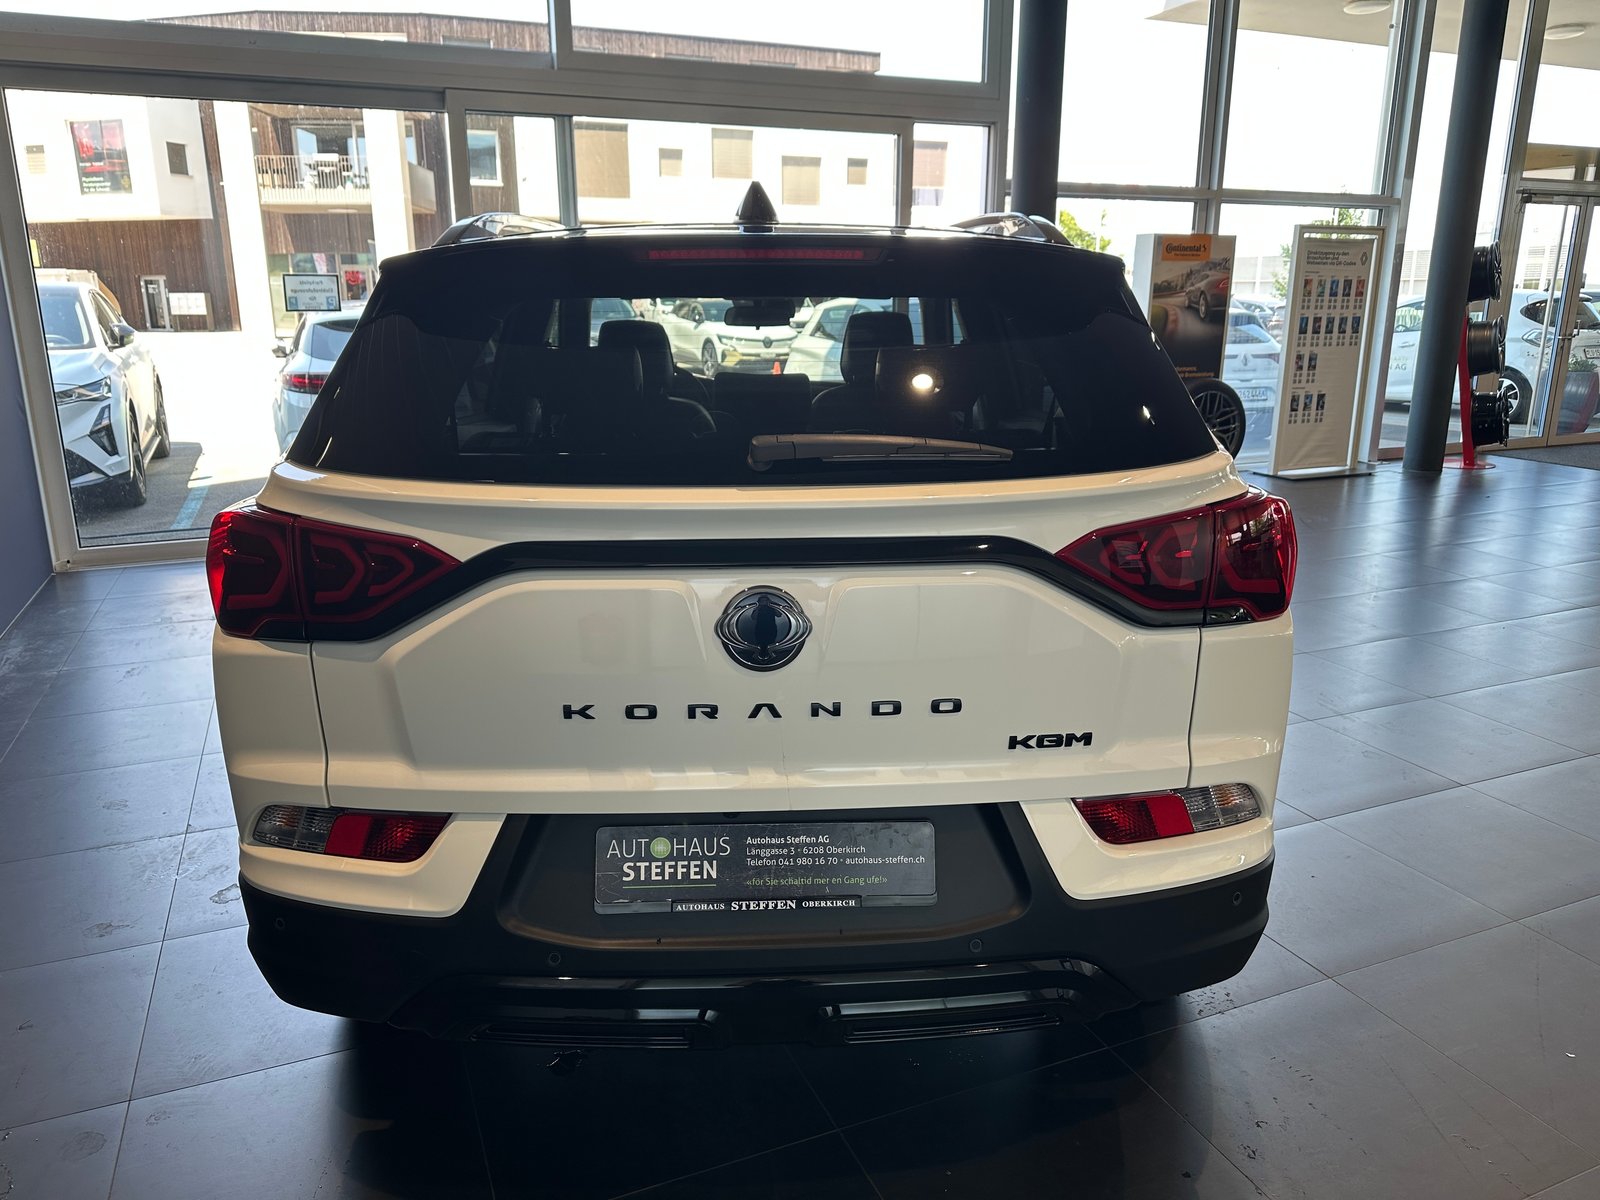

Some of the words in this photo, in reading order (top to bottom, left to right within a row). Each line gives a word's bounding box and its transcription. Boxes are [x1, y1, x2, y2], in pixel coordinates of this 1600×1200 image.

[1166, 243, 1202, 254] Continental
[563, 698, 963, 720] KORANDO
[1008, 732, 1093, 750] KGM
[746, 836, 785, 845] Autohaus
[786, 835, 816, 844] Steffen
[818, 835, 830, 843] AG
[746, 847, 788, 857] Länggasse
[790, 847, 795, 855] 3
[803, 846, 824, 854] 6208
[826, 845, 866, 854] Oberkirch
[746, 858, 777, 866] Telefon
[796, 857, 813, 865] 980
[815, 857, 825, 865] 16
[845, 855, 926, 864] autohaus-steffen.ch
[622, 860, 717, 881] STEFFEN
[765, 877, 778, 885] Sie
[843, 875, 865, 885] Gang
[676, 903, 725, 911] AUTOHAUS
[731, 899, 796, 911] STEFFEN
[802, 899, 855, 908] OBERKIRCH
